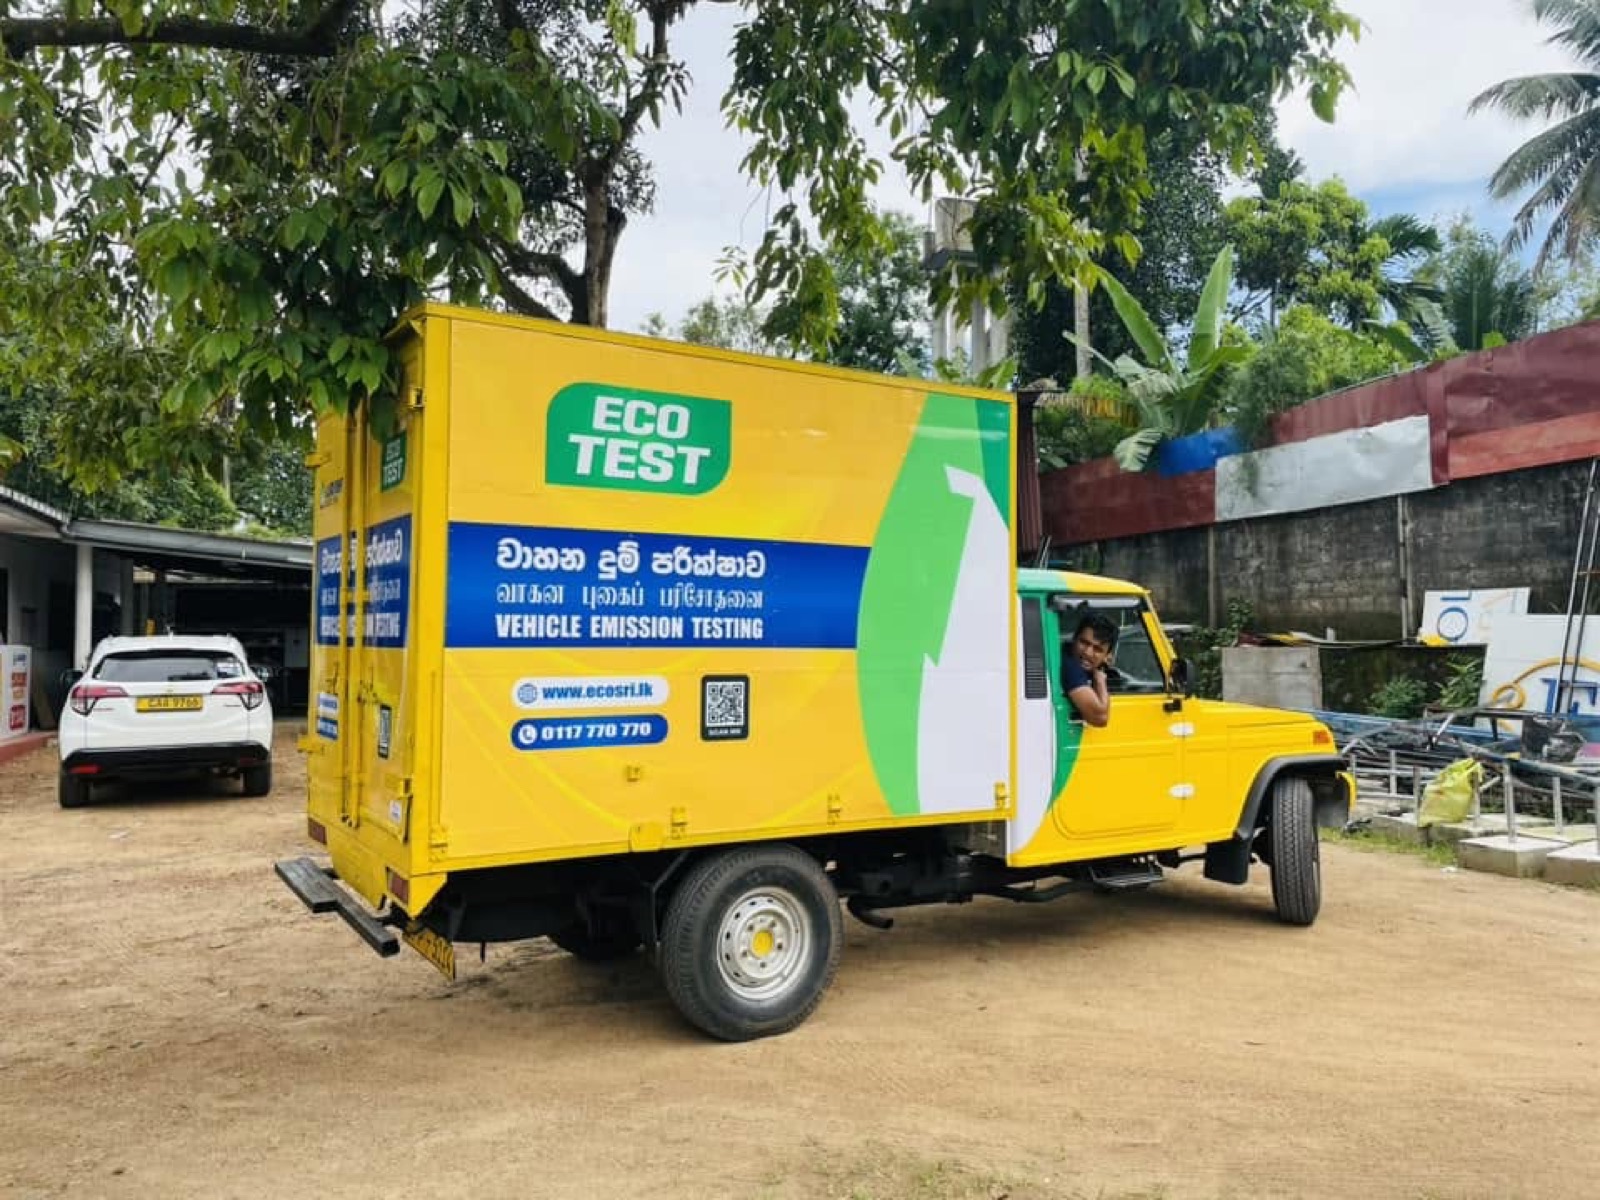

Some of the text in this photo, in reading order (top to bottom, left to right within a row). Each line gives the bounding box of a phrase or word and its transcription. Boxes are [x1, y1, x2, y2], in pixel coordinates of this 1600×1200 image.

[593, 396, 690, 440] ECO
[568, 433, 710, 485] TEST
[496, 537, 586, 571] වාහන
[496, 583, 564, 604] வாகன
[582, 580, 644, 610] புகைப்
[496, 614, 763, 639] VEHICLE EMISSION TESTING
[542, 682, 653, 700] www.ecosri.lk
[541, 722, 652, 741] 0117 770 770
